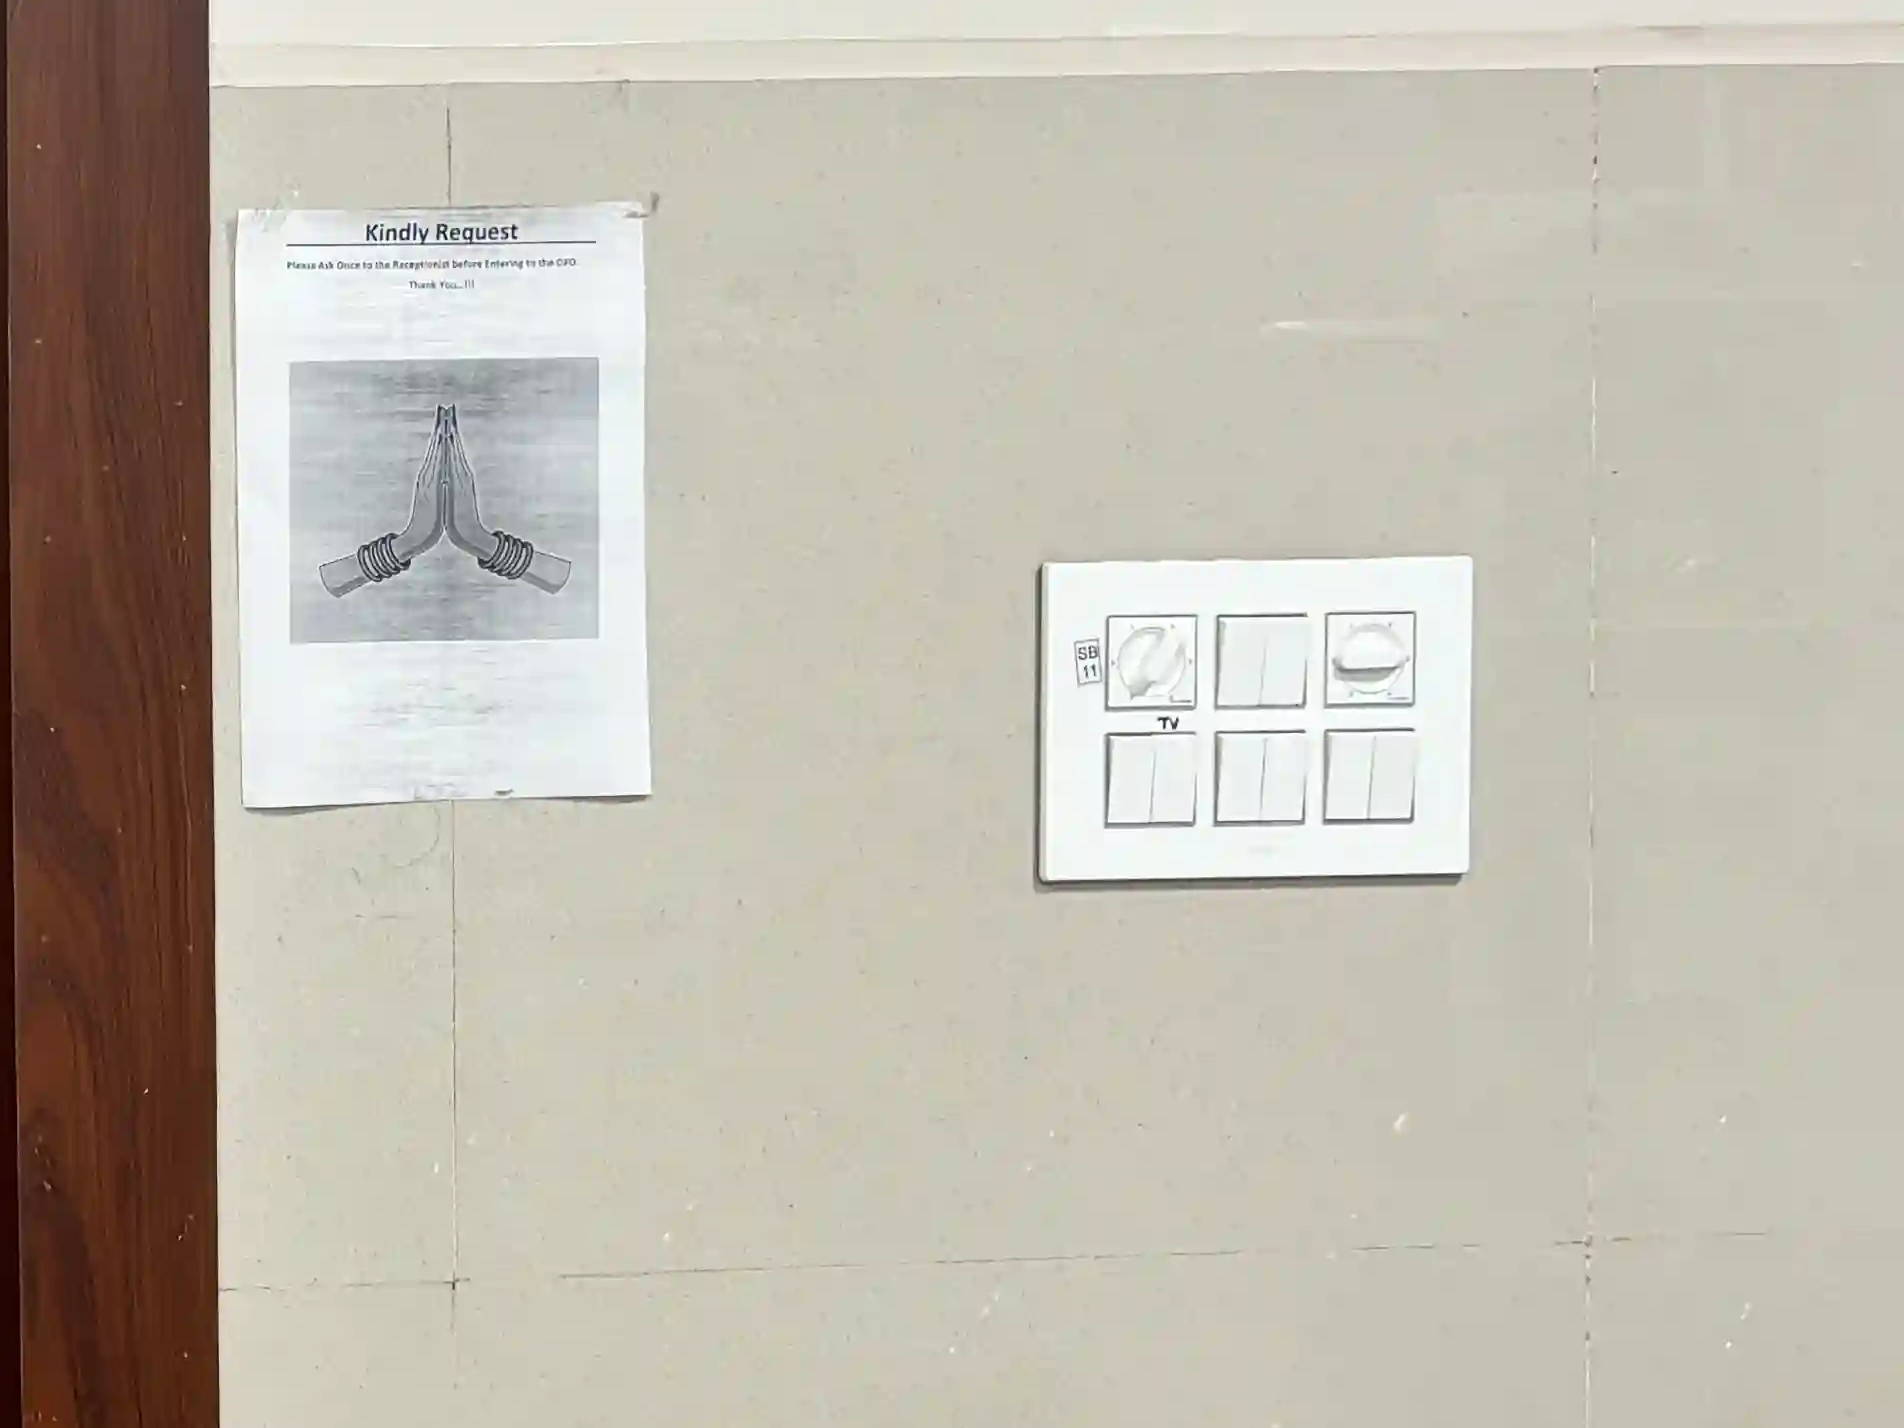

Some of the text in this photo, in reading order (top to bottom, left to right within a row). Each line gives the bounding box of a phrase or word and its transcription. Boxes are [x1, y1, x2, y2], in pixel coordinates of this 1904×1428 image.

[365, 222, 519, 244] Kindly Request
[318, 260, 334, 270] Ask
[336, 260, 361, 270] Once
[362, 260, 373, 270] to
[375, 259, 390, 270] the
[452, 258, 482, 269] before
[485, 258, 523, 270] Entering
[409, 280, 436, 290] Thank
[1078, 646, 1098, 660] SB
[1157, 716, 1179, 730] TV
